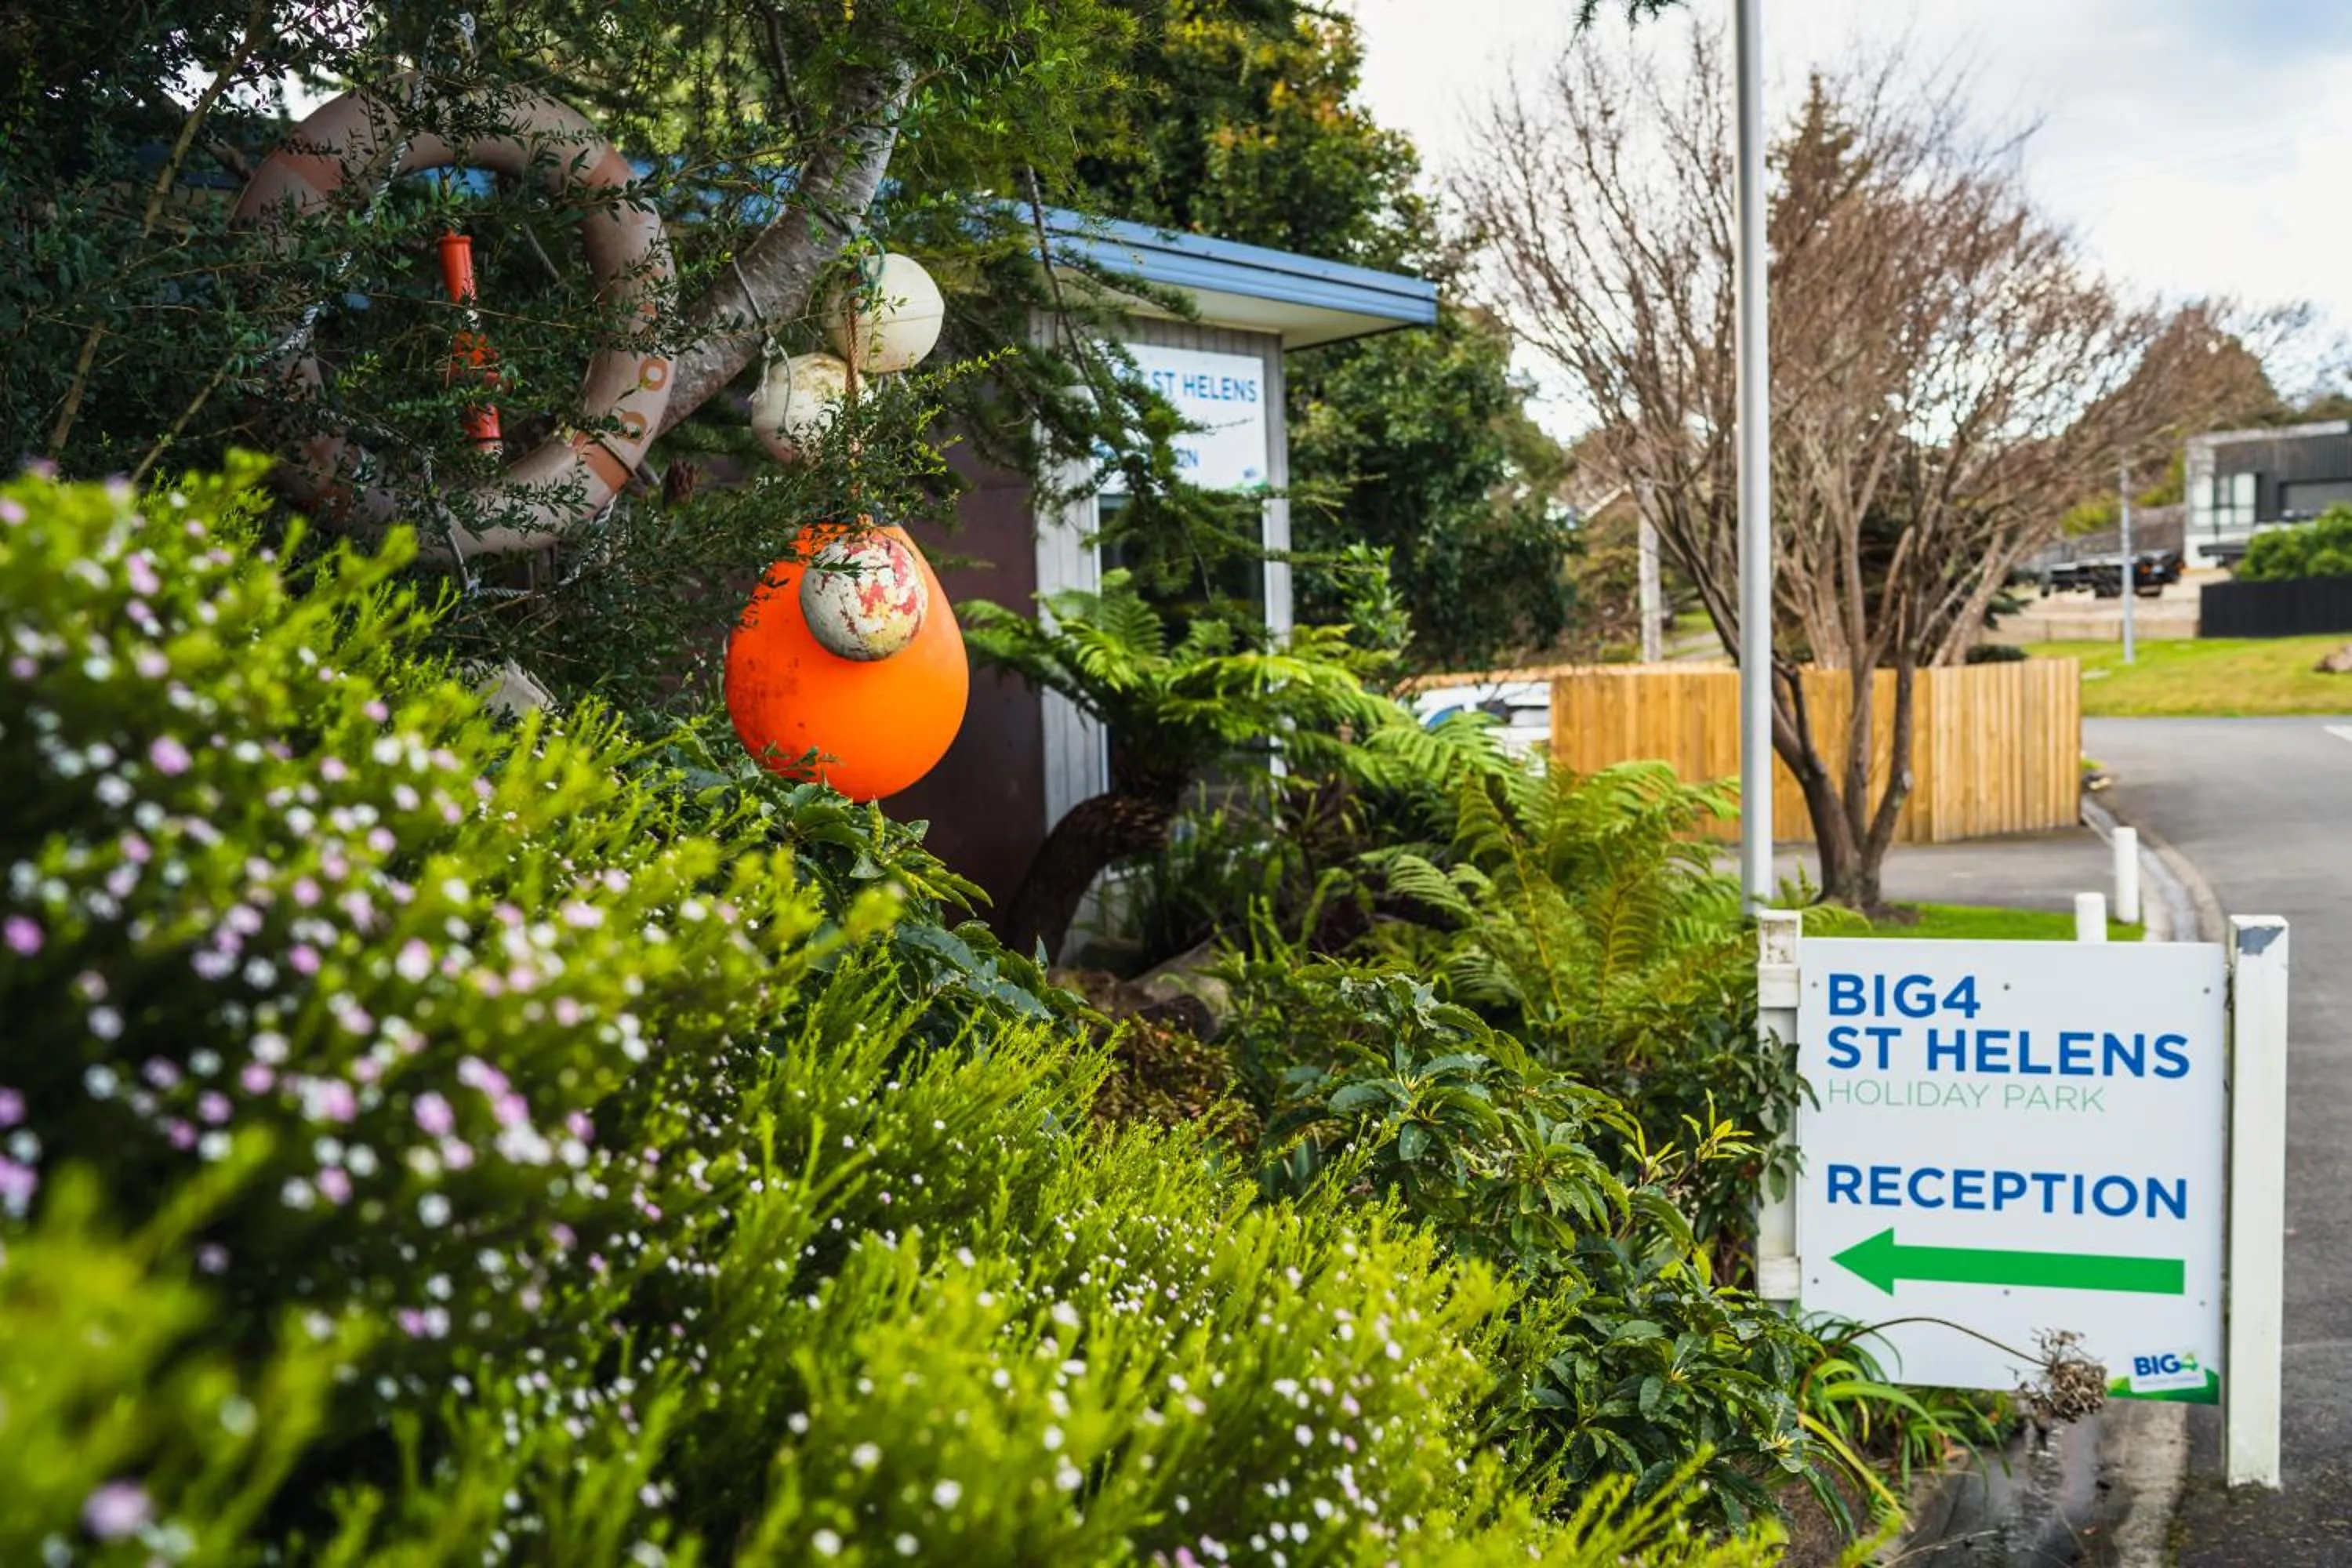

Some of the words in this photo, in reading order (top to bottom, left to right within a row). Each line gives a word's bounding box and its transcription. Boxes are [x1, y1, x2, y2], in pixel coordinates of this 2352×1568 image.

[1152, 370, 1175, 395] ST
[1182, 372, 1258, 403] HELENS
[1828, 972, 1981, 1020] BIG4
[1826, 1024, 1903, 1072] ST
[1926, 1027, 2191, 1080] HELENS
[1828, 1077, 1991, 1109] HOLIDAY
[2003, 1082, 2106, 1114] PARK
[1826, 1163, 2188, 1221] RECEPTION
[2132, 1352, 2200, 1377] BIG4
